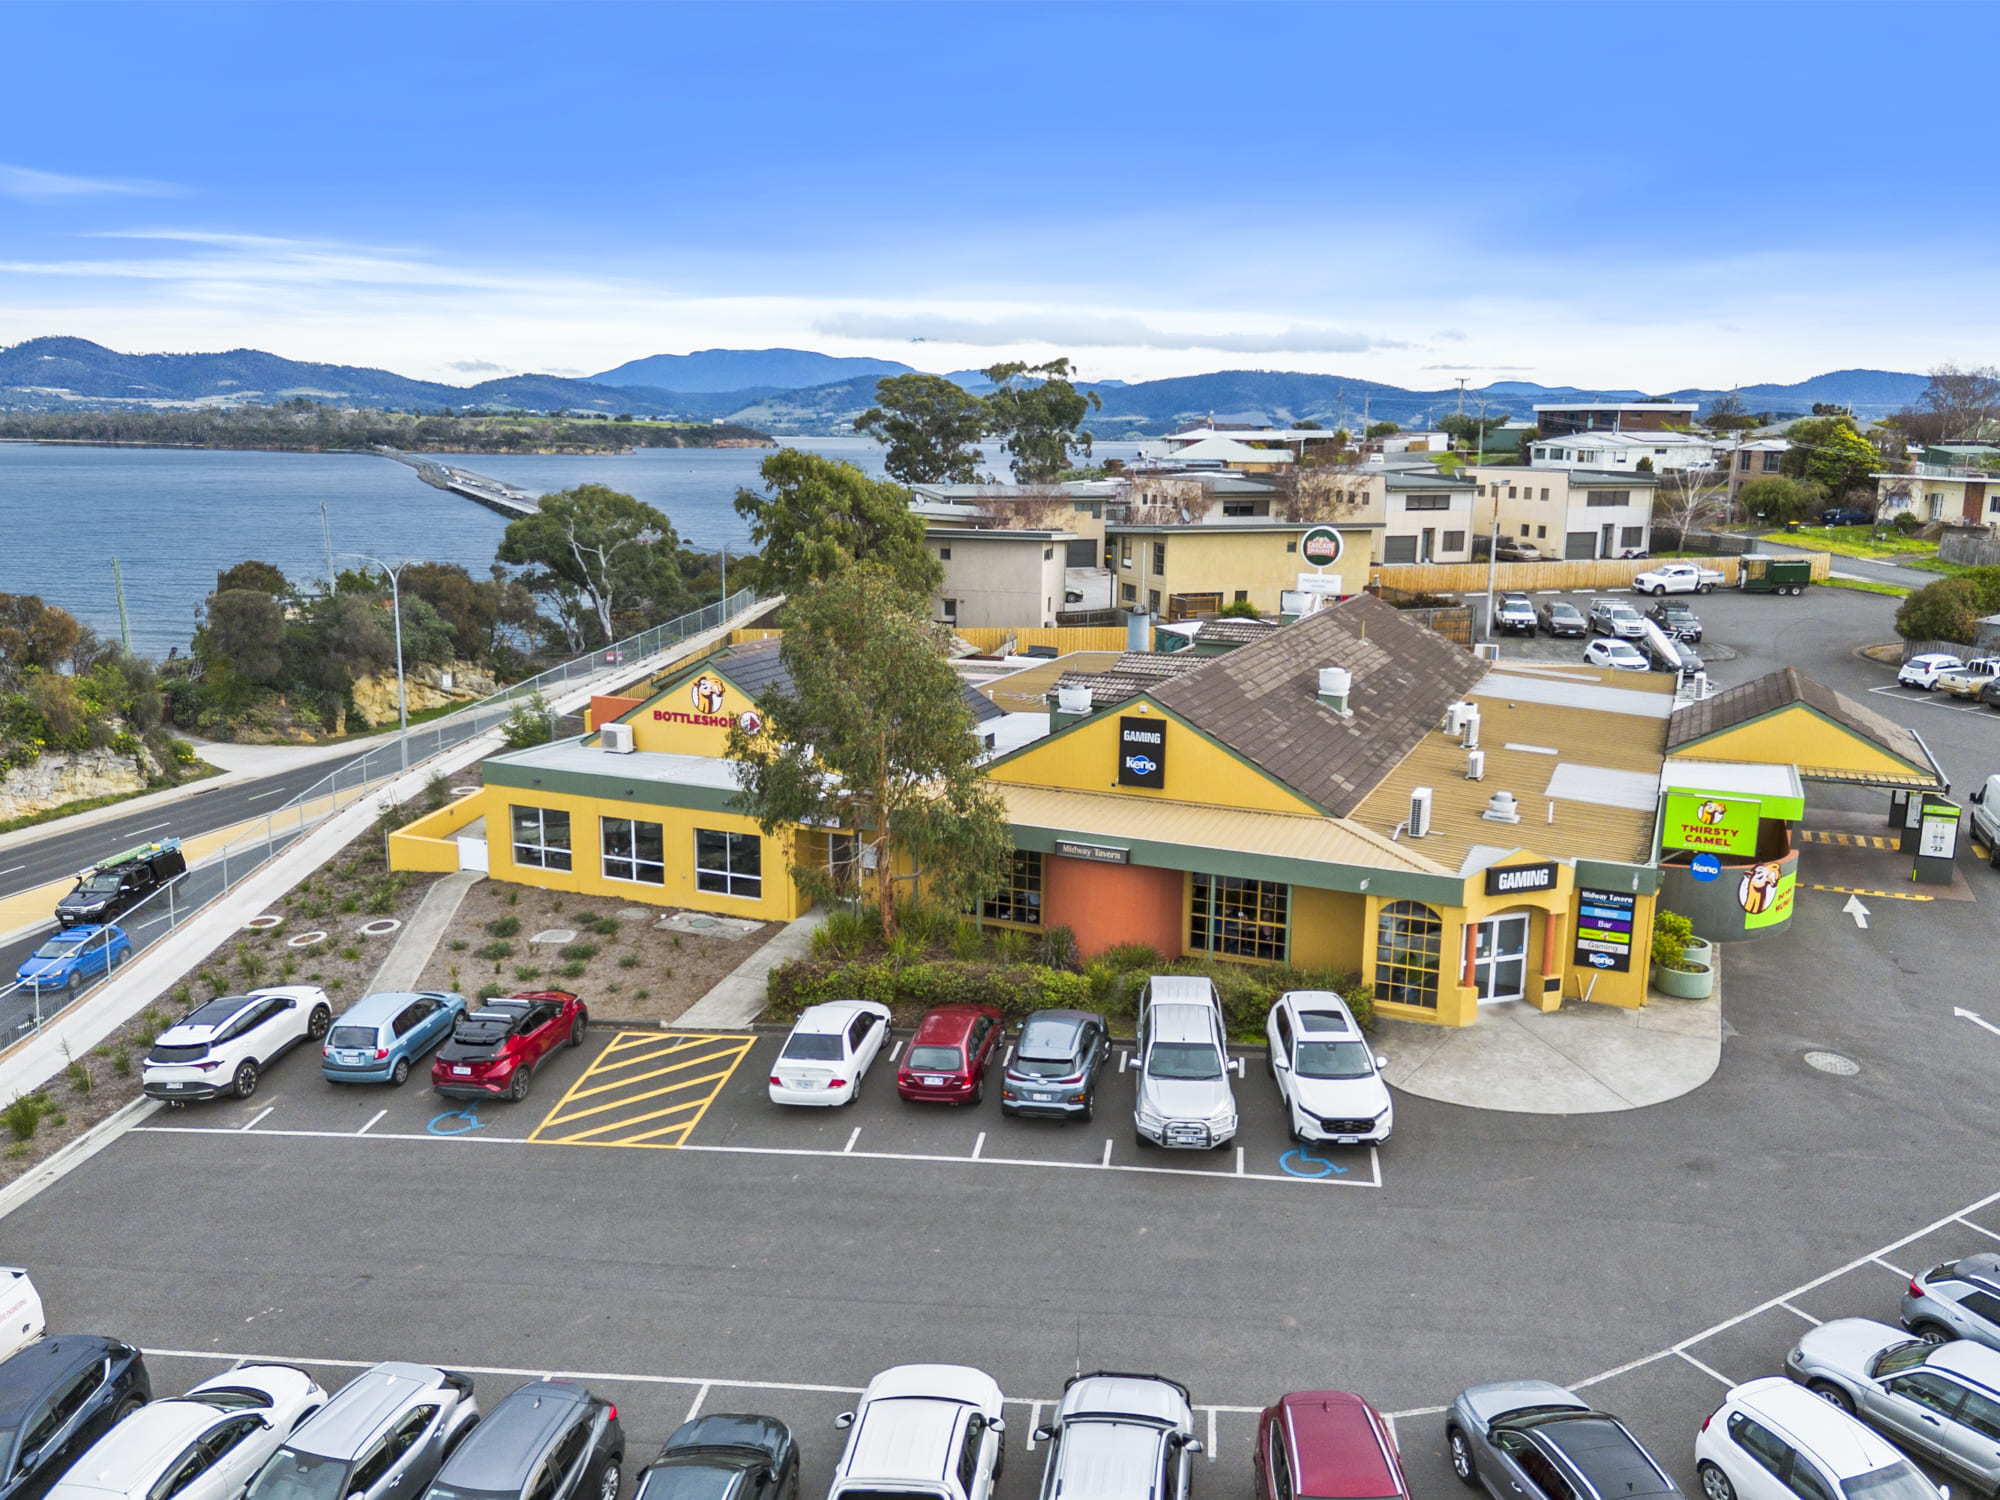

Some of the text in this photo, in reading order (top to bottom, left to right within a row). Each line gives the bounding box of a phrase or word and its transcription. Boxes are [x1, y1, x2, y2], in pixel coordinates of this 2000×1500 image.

[1123, 730, 1161, 744] GAMING
[1681, 824, 1739, 837] THIRSTY
[1685, 835, 1731, 846] CAMEL
[1062, 845, 1121, 860] Midway Tavern
[1499, 869, 1549, 890] GAMING
[1582, 891, 1633, 904] Midway Tavern
[1597, 920, 1613, 929] Bar
[1587, 941, 1618, 952] Gaming
